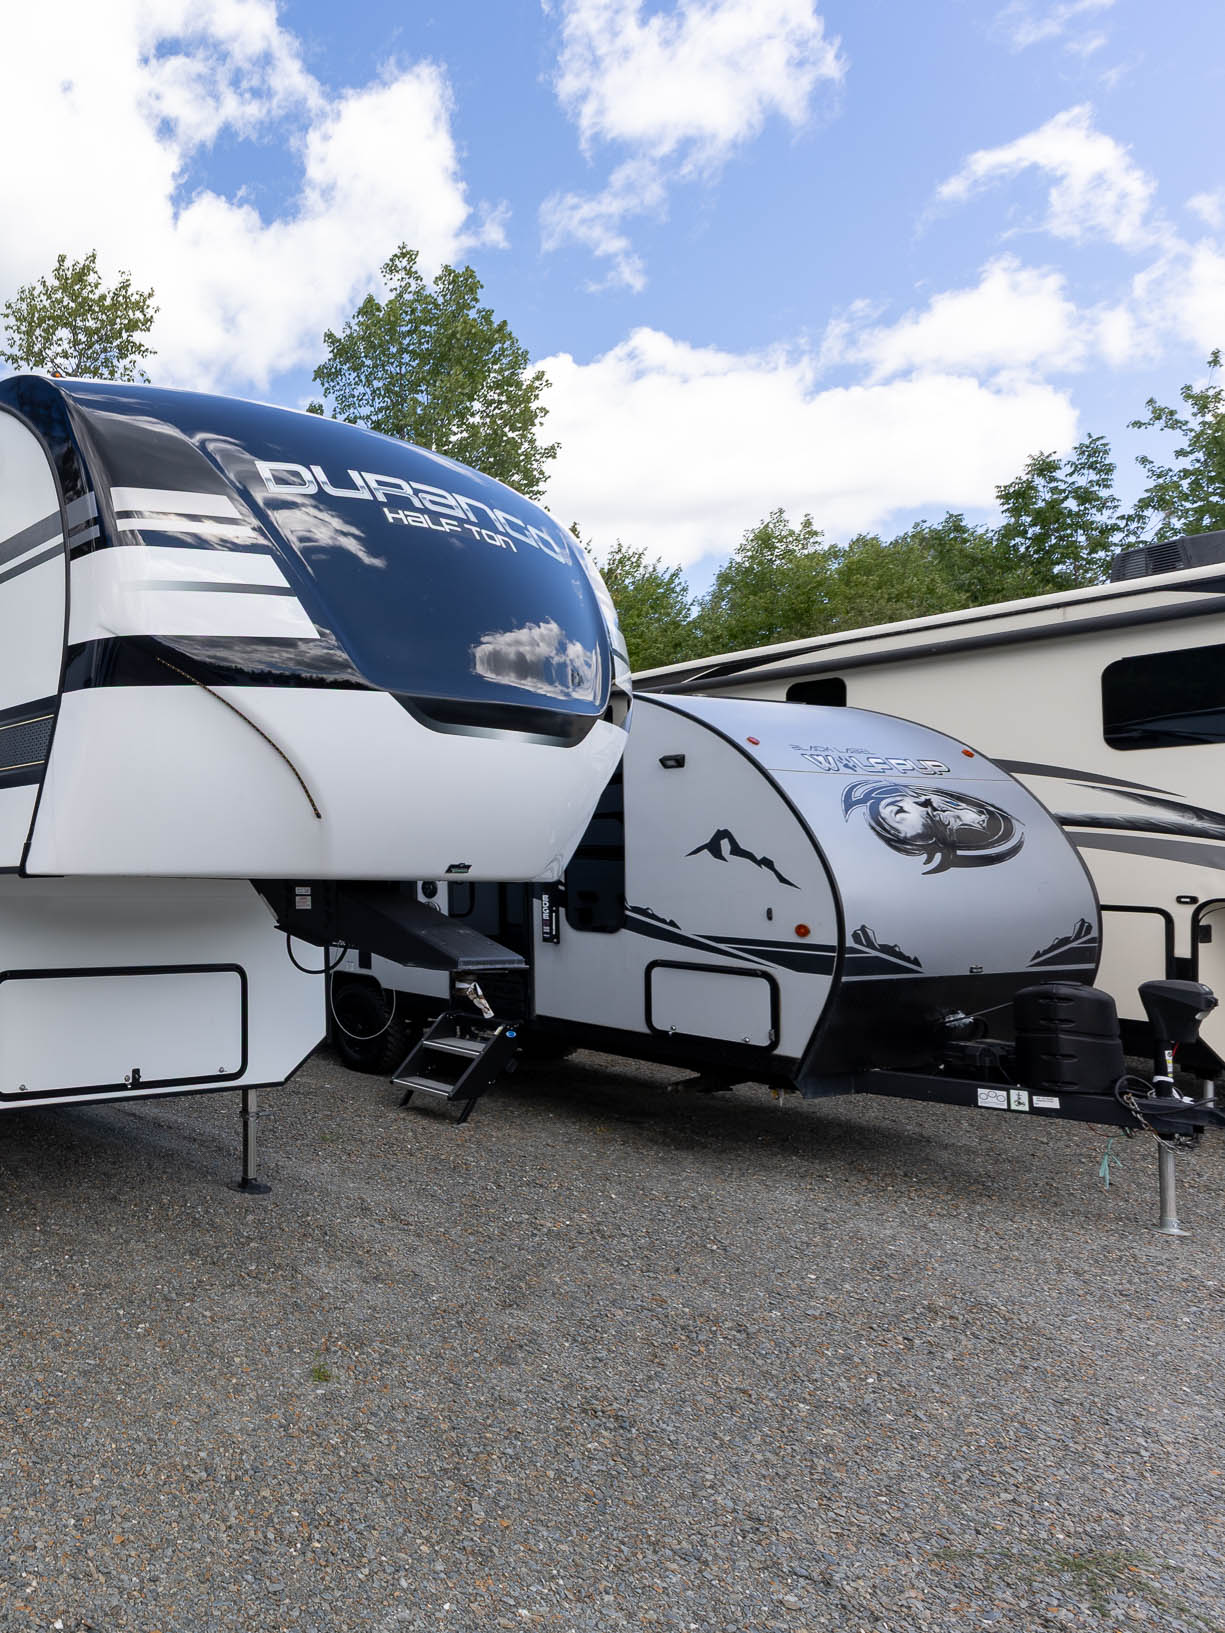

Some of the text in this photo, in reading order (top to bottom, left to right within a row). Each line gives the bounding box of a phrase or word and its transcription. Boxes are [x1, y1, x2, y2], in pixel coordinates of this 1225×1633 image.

[383, 507, 517, 552] HALF TON
[885, 757, 951, 776] PUP
